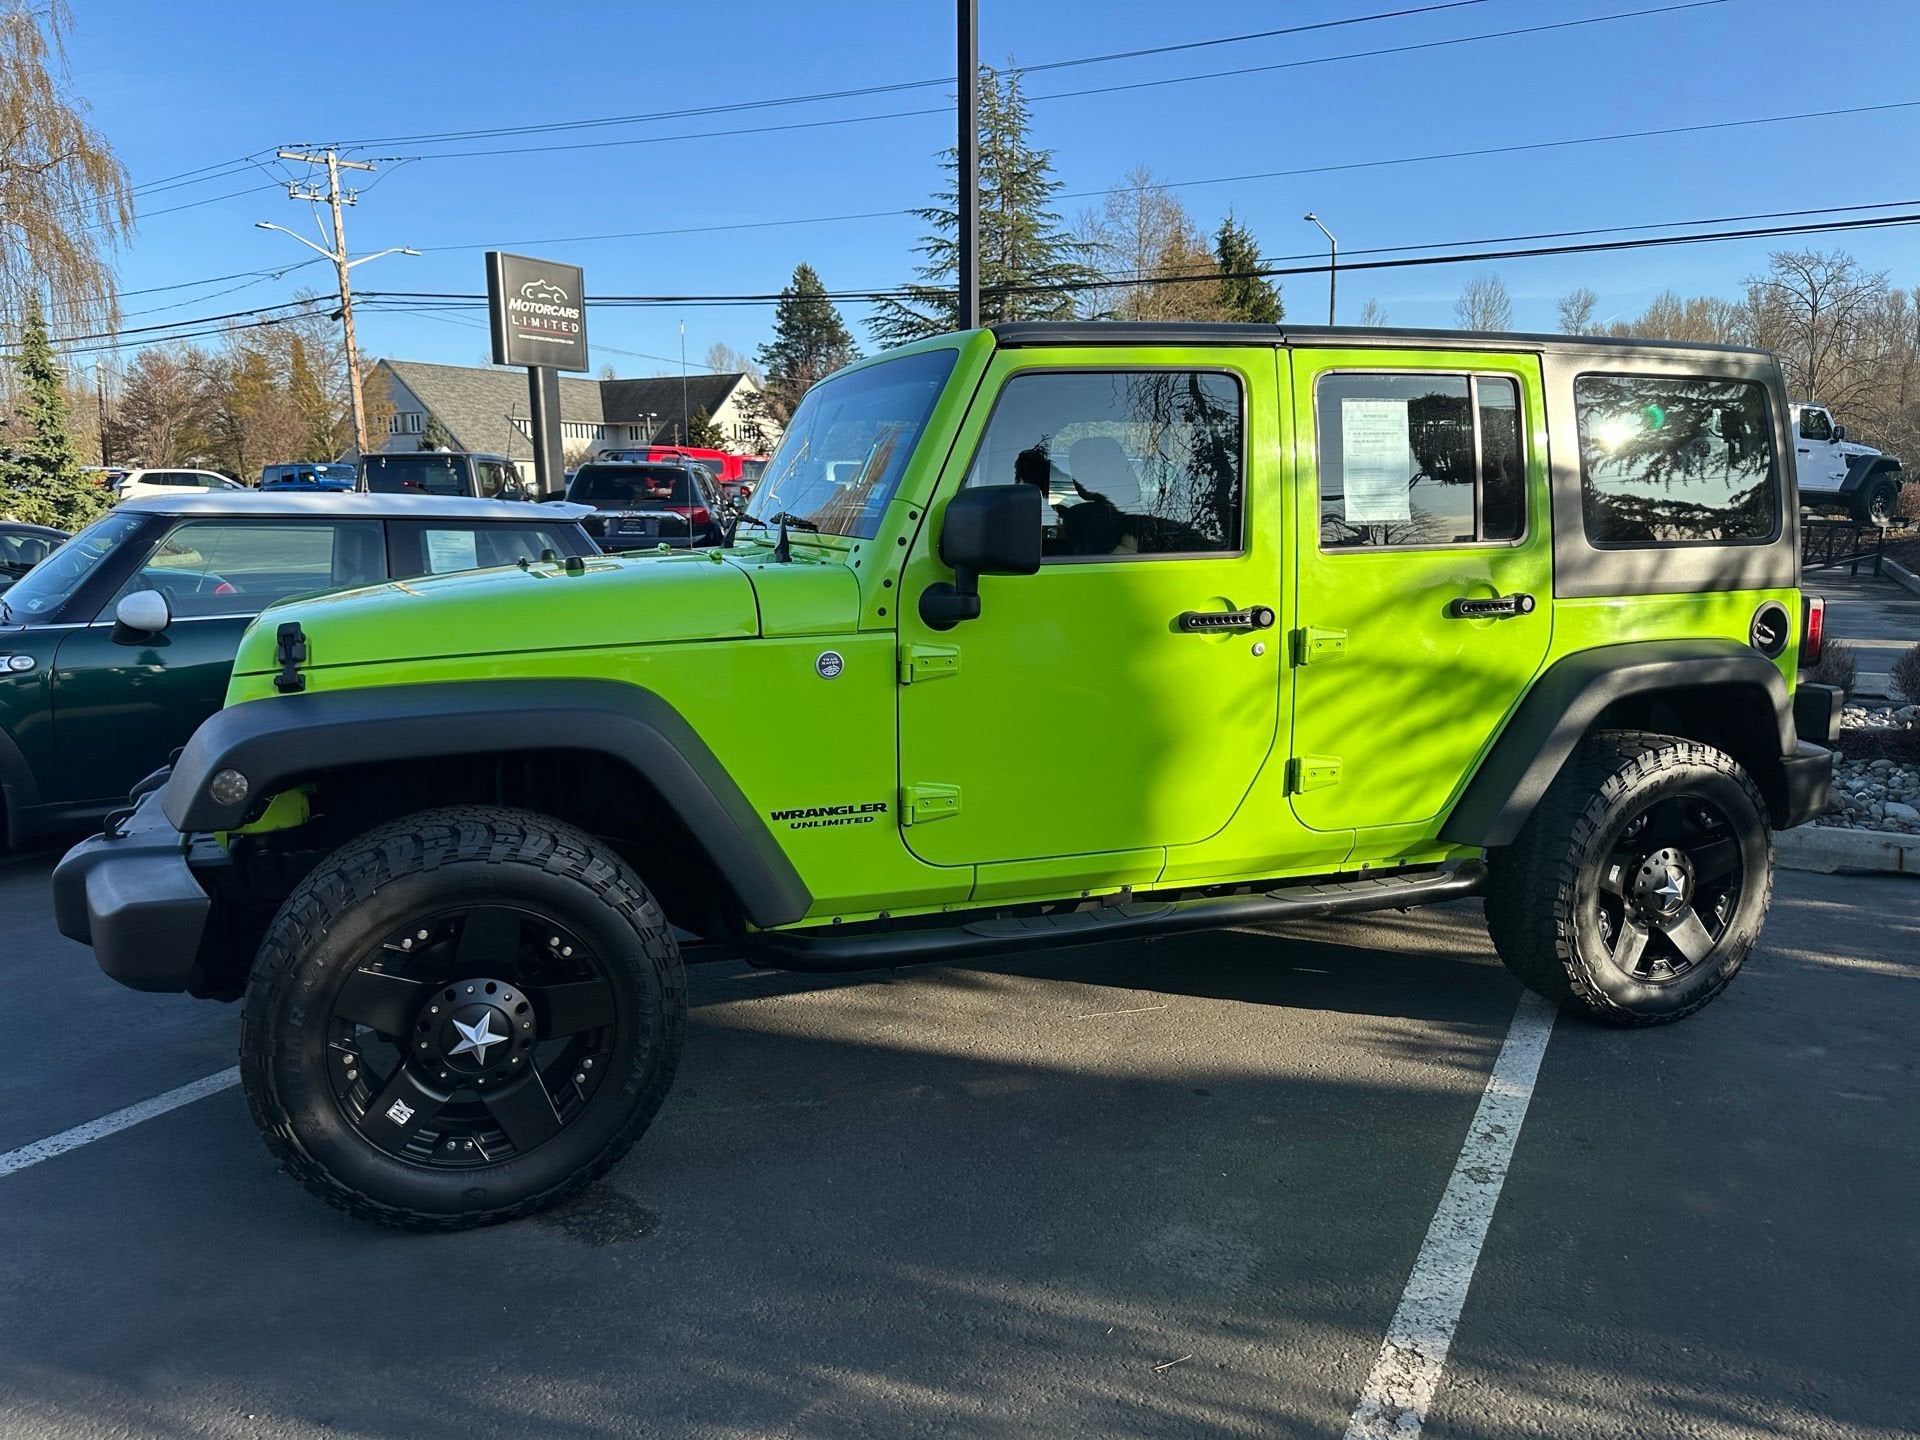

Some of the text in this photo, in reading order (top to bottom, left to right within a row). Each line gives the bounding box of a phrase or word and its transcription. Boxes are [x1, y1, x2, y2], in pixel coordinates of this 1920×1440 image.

[509, 298, 579, 319] MOTORCARS
[770, 803, 887, 821] WRANGLER
[790, 816, 874, 829] UNLIMITED
